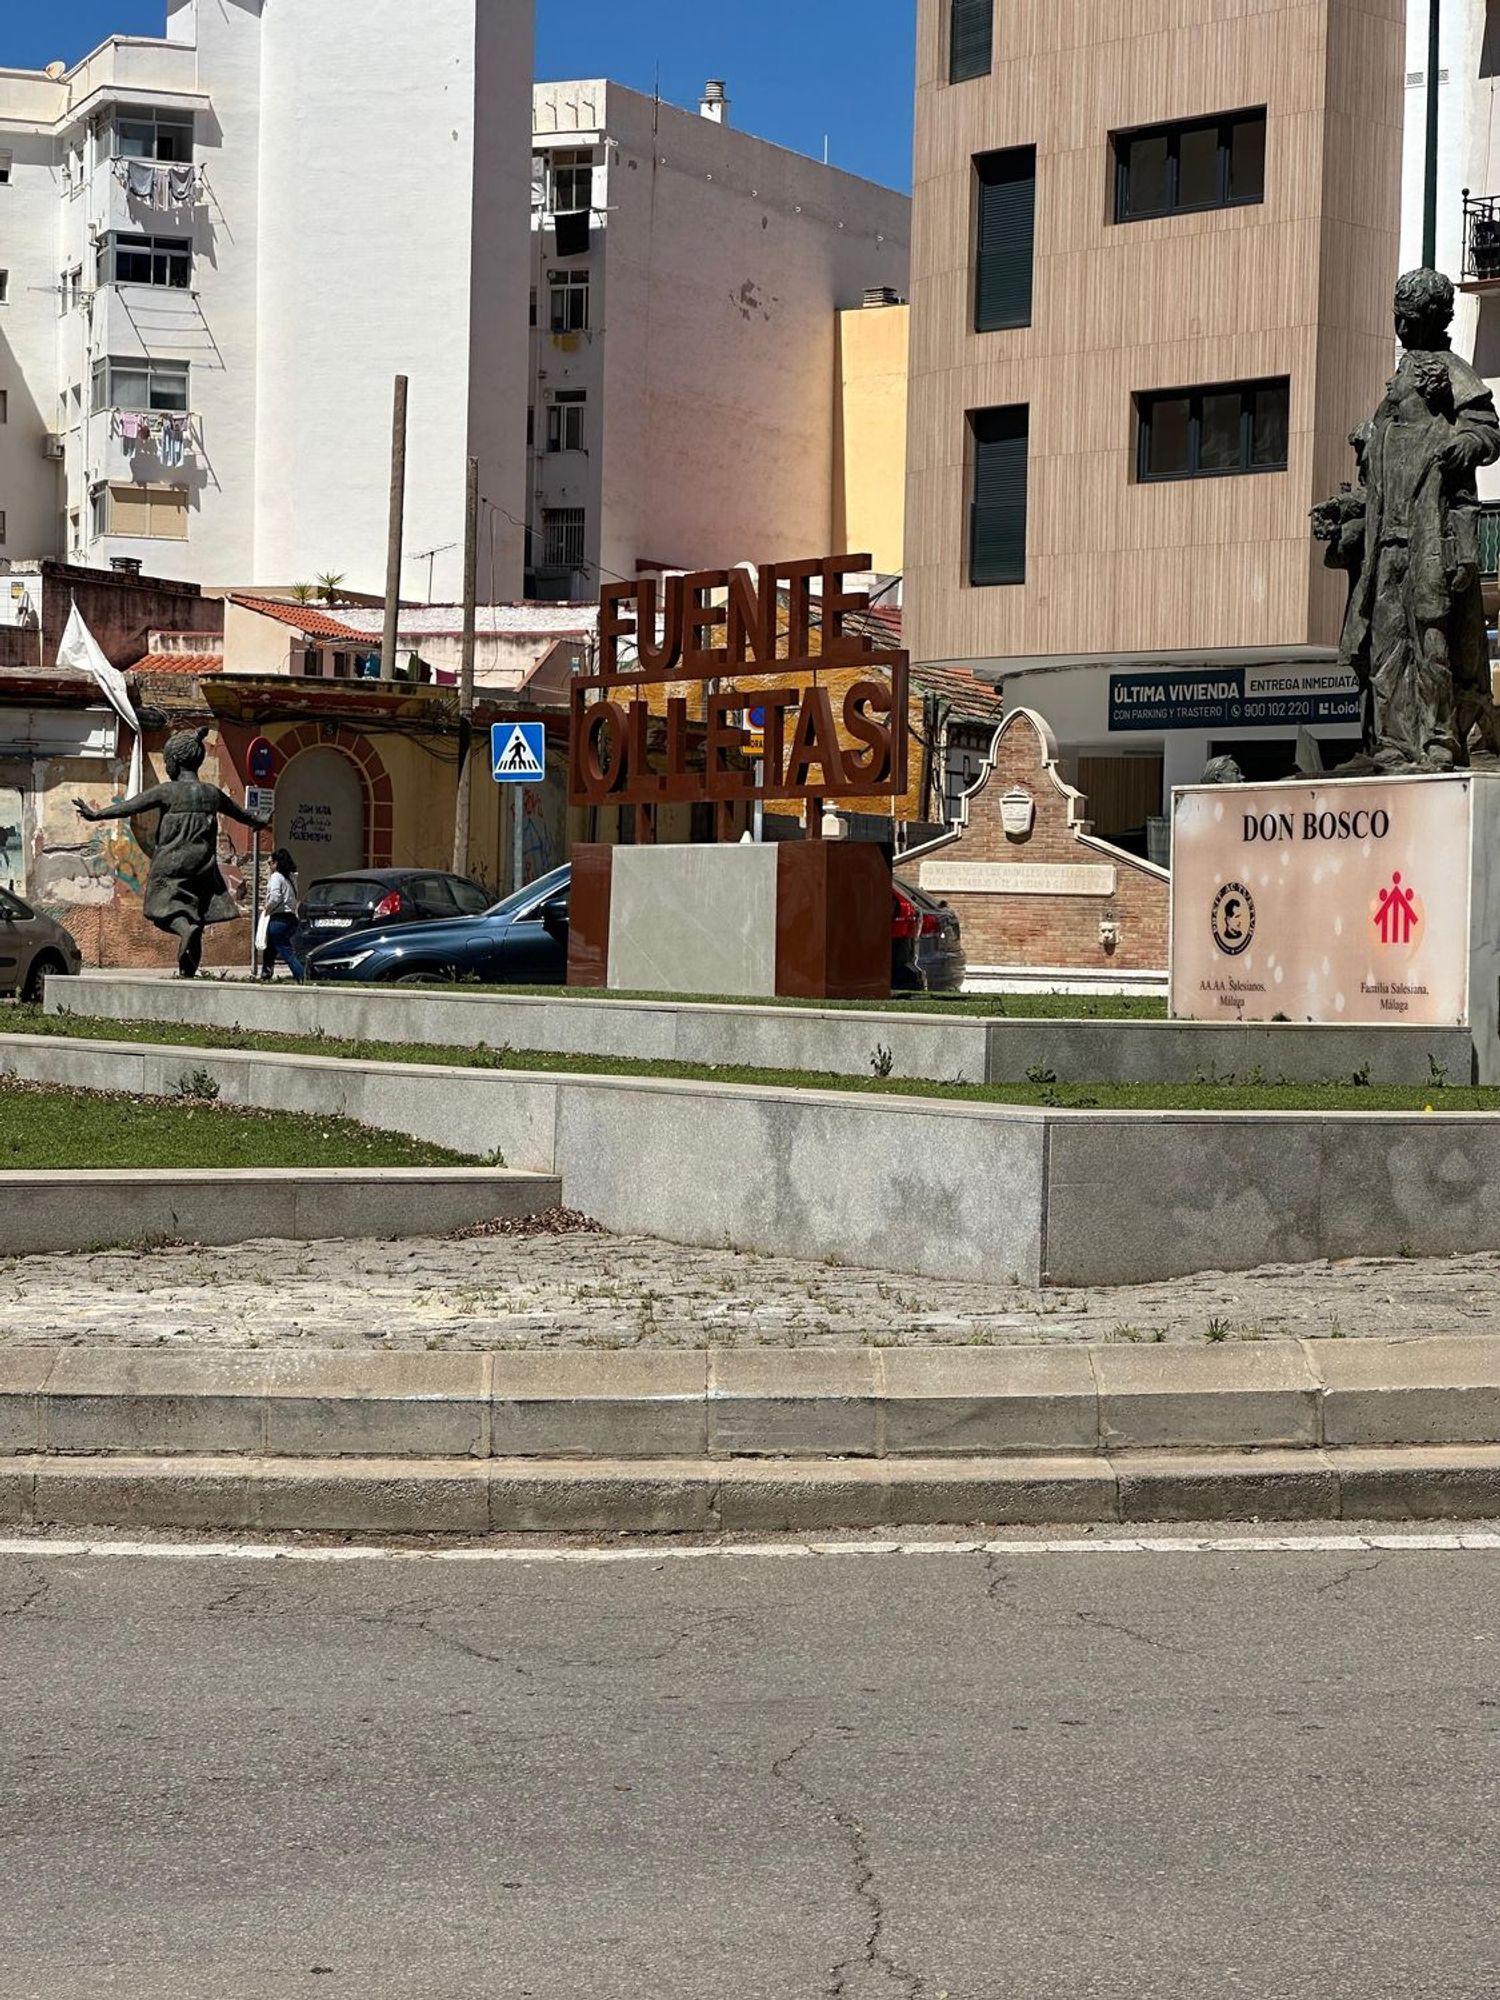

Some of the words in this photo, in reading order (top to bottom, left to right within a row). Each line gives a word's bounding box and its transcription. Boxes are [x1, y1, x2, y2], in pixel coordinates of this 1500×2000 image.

[600, 553, 872, 674] FUENTE
[1114, 684, 1165, 703] ÚLTIMA
[1169, 682, 1240, 701] VIVIENDA
[1250, 678, 1300, 691] ENTREGA
[1302, 675, 1360, 689] INMEDIATA
[1113, 709, 1131, 720] CON
[1132, 707, 1168, 719] PARKING
[1169, 707, 1176, 718] Y
[1177, 705, 1223, 718] TRASTERO
[1244, 702, 1265, 717] 900
[1268, 702, 1286, 716] 102
[1288, 701, 1309, 715] 220
[580, 681, 893, 793] OLLETAS
[1242, 813, 1294, 841] DON
[1302, 809, 1389, 840] BOSCO
[1360, 981, 1389, 994] Familia
